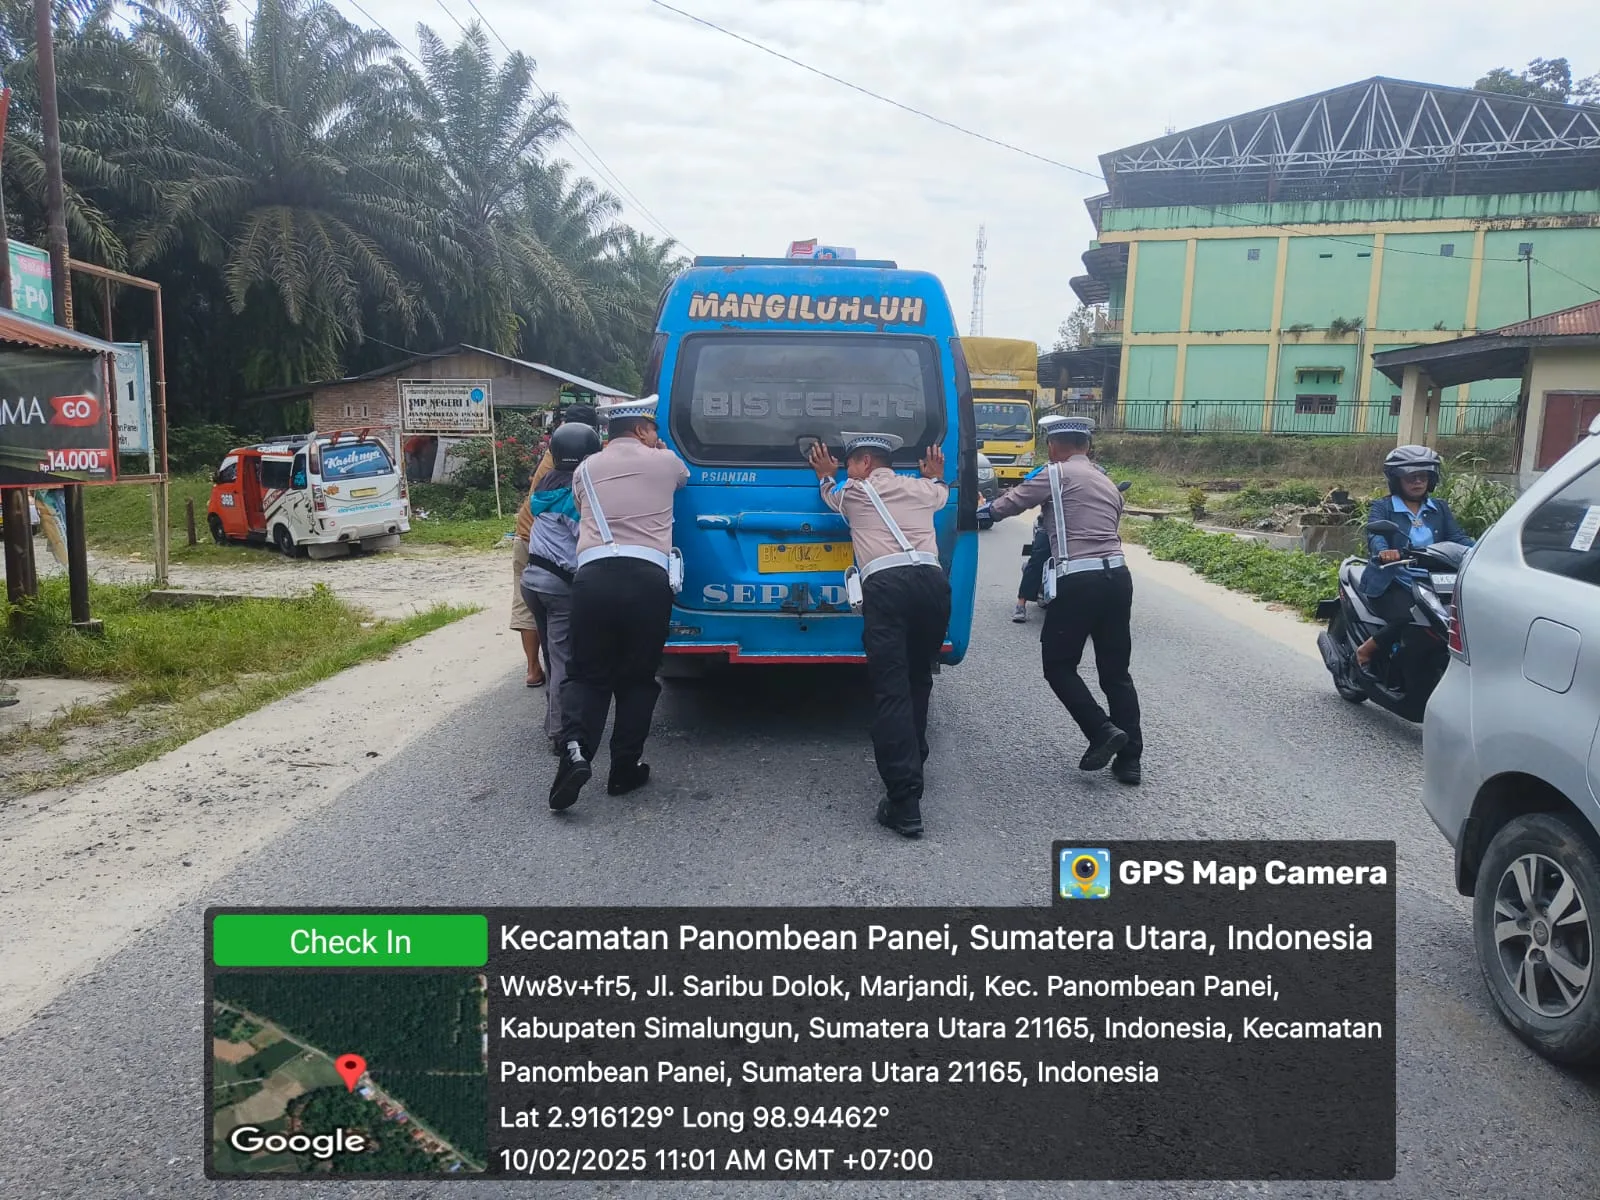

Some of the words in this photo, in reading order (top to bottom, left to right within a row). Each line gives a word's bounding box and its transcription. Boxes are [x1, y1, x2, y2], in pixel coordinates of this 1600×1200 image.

[126, 380, 135, 401] 1
[0, 396, 46, 425] MA
[62, 400, 91, 419] GO
[408, 398, 427, 408] SMP
[430, 398, 462, 409] NEGERI
[466, 398, 471, 407] 1
[703, 391, 769, 418] BIS
[776, 391, 917, 419] CEPAT
[700, 471, 757, 483] P.SIANTAR
